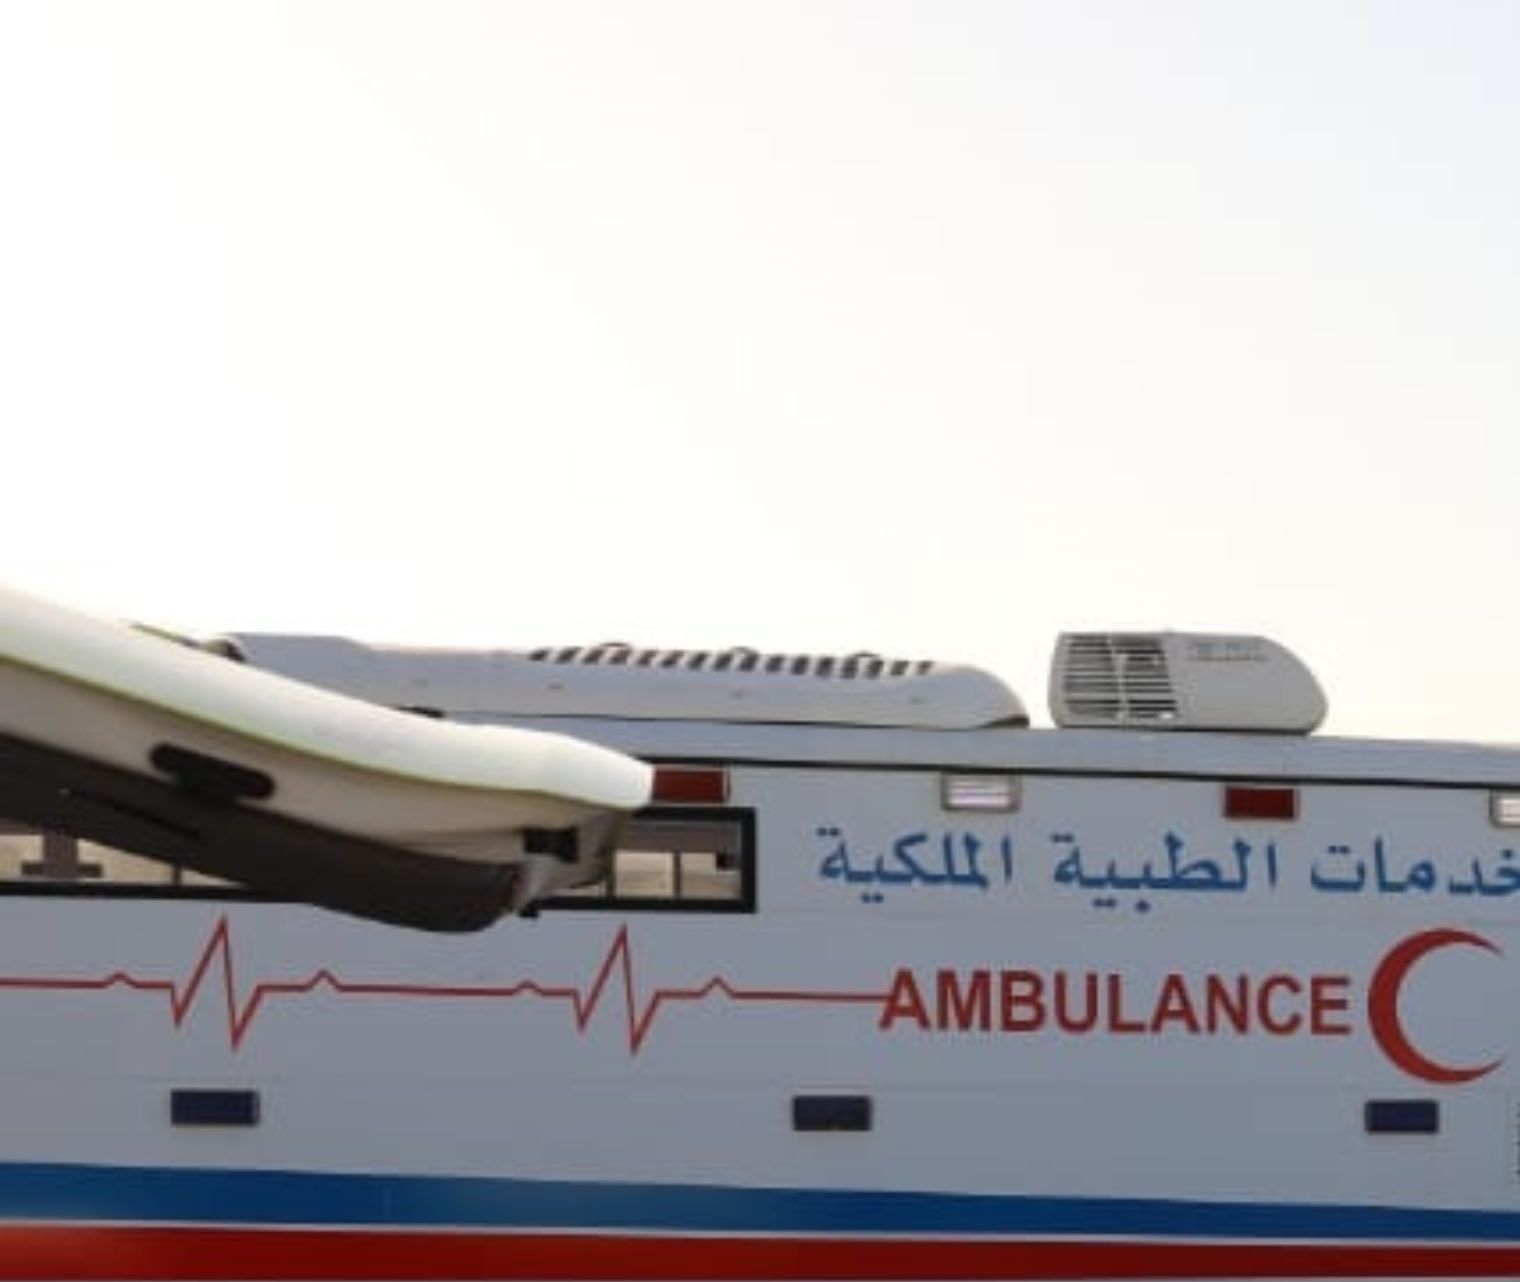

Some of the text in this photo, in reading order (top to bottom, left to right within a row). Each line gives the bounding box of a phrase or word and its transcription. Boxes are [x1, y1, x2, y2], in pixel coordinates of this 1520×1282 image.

[815, 827, 1013, 902] الملكية
[1051, 832, 1278, 914] الطبية
[878, 970, 1352, 1034] AMBULANCE
